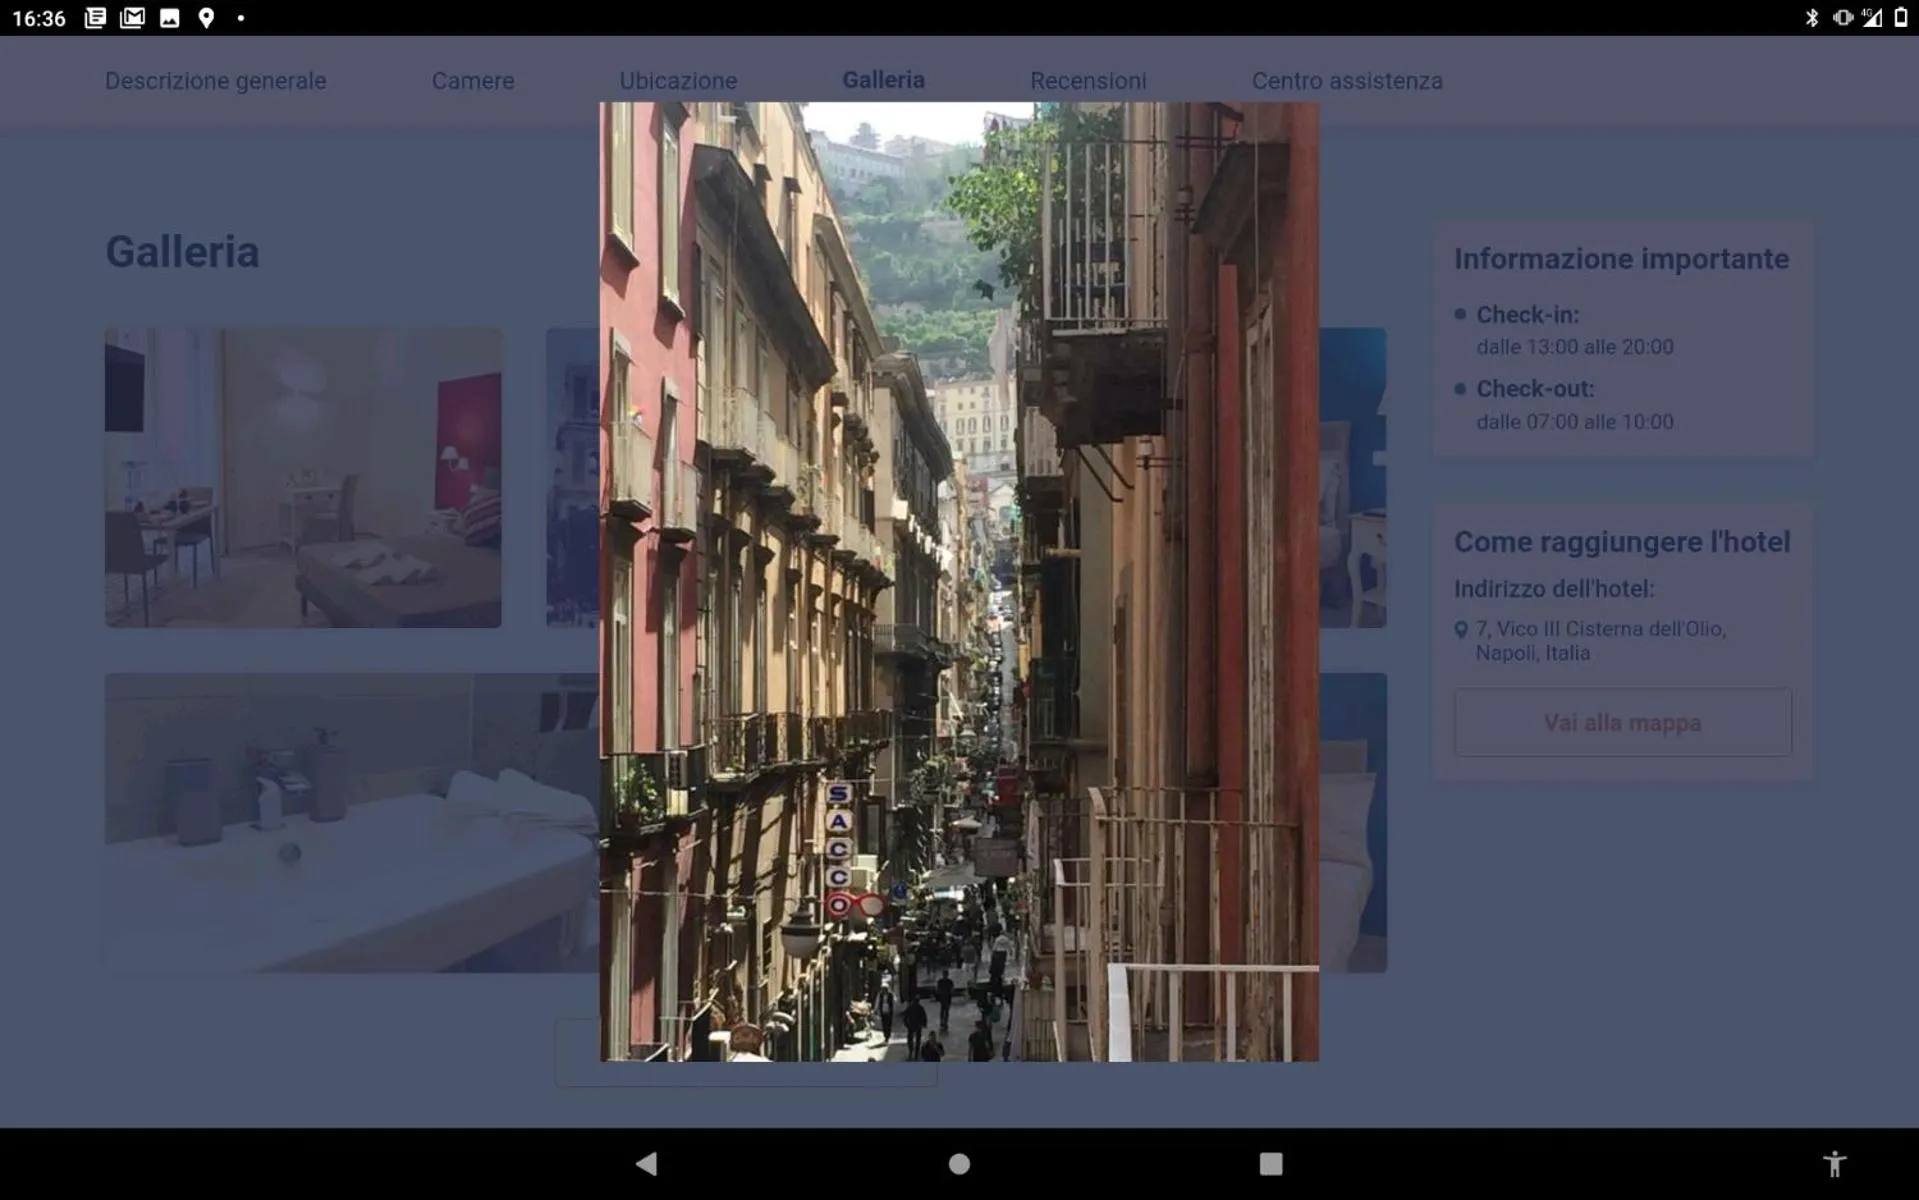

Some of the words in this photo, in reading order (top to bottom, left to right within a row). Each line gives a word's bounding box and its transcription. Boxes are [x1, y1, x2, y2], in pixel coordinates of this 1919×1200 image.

[13, 11, 66, 27] 16:36
[105, 71, 229, 90] Descrizione
[236, 71, 327, 94] generale
[433, 71, 515, 90] Camere
[620, 71, 738, 90] Ubicazione
[842, 70, 926, 90] Galleria
[1031, 71, 1147, 90] Recensioni
[1253, 72, 1323, 90] Centro
[1330, 72, 1443, 90] assistenza
[106, 234, 260, 268] Galleria
[1455, 246, 1634, 270] Informazione
[1643, 246, 1790, 275] importante
[1477, 304, 1580, 324] Check-in:
[1477, 338, 1521, 355] dalle
[1528, 339, 1579, 355] 13:00
[1584, 338, 1616, 355] alle
[1623, 339, 1674, 355] 20:00
[1477, 379, 1595, 399] Check-out:
[1477, 413, 1521, 430] dalle
[1527, 413, 1579, 430] 07:00
[1584, 413, 1616, 430] alle
[1623, 413, 1674, 430] 10:00
[1455, 530, 1533, 554] Come
[1541, 530, 1703, 559] raggiungere
[1711, 529, 1791, 554] l'hotel
[1455, 578, 1546, 599] Indirizzo
[1553, 578, 1655, 599] dell'hotel:
[1476, 620, 1492, 640] 7,
[1497, 620, 1538, 637] Vico
[1544, 620, 1560, 637] III
[1566, 620, 1643, 637] Cisterna
[1649, 620, 1727, 640] dell'Olio,
[1476, 644, 1540, 664] Napoli,
[1546, 644, 1591, 661] Italia
[1544, 713, 1578, 732] Vai
[1584, 713, 1623, 732] alla
[1629, 717, 1702, 738] mappa
[829, 786, 849, 911] SACCO
